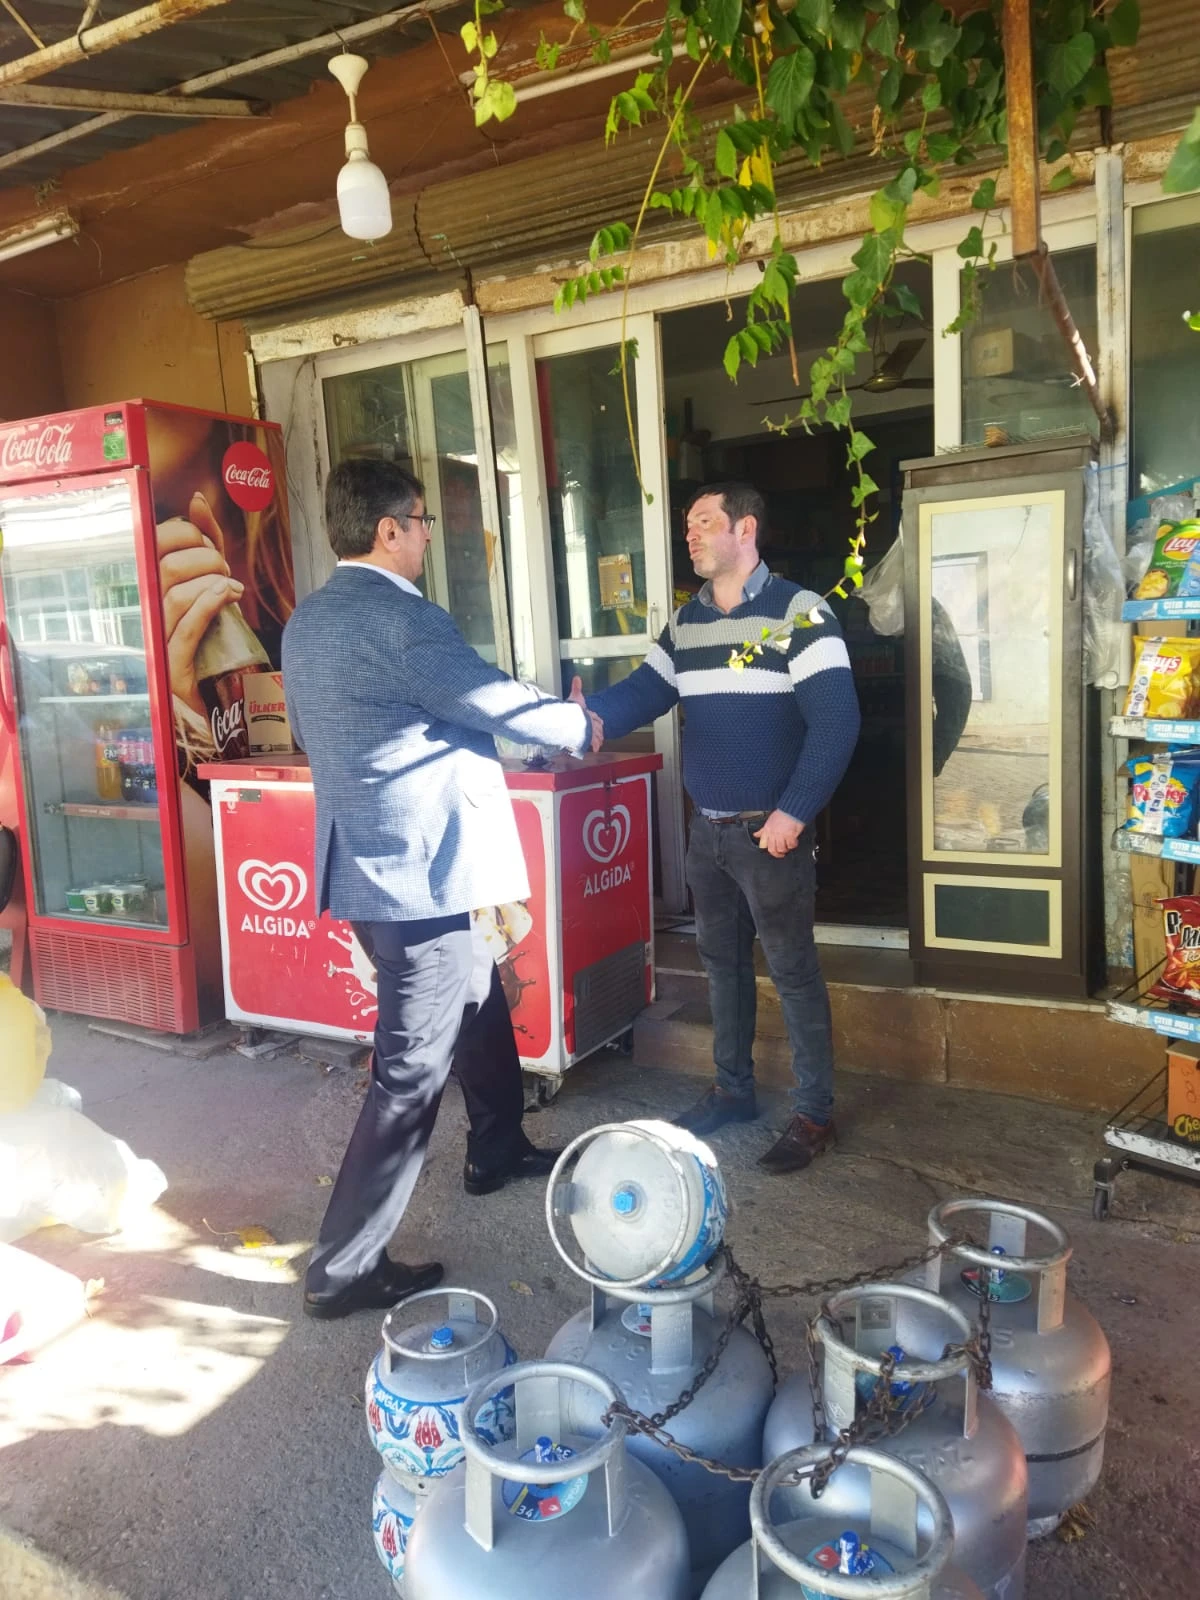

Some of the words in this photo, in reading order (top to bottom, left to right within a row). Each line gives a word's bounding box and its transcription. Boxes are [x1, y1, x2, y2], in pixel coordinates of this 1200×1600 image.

[2, 422, 75, 470] Coca-Cola
[225, 463, 271, 489] Coca-Cola
[248, 700, 286, 714] ÜLKER
[516, 1504, 534, 1518] 34
